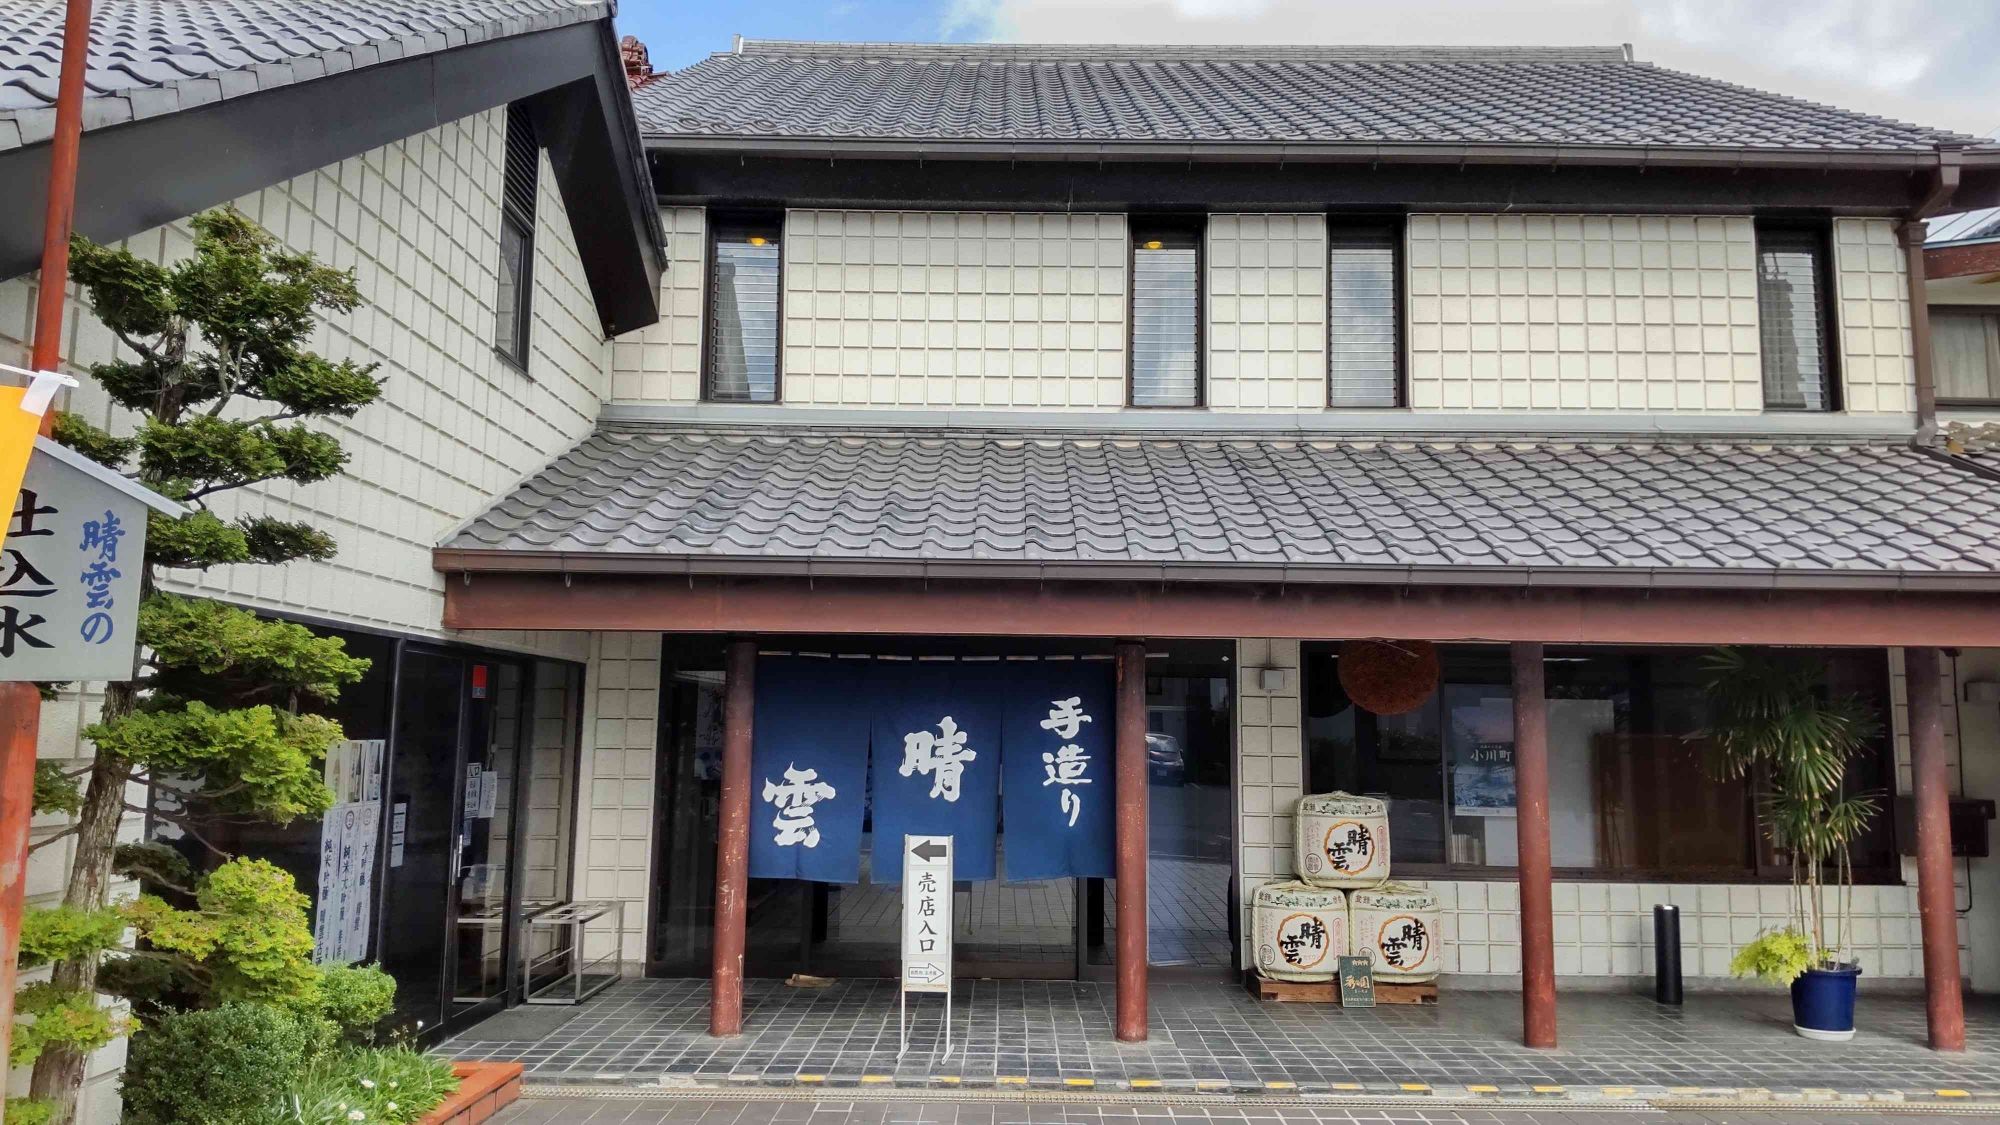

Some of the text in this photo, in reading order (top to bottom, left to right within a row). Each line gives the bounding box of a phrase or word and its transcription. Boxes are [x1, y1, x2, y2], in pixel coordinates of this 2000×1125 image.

[79, 509, 126, 645] 晴雲の
[899, 715, 977, 802] 晴
[1040, 696, 1093, 827] 手造り
[1470, 749, 1512, 762] 小川町
[762, 761, 836, 848] 雲
[1327, 824, 1371, 871] 晴雲
[918, 872, 938, 953] 売店入口
[1280, 916, 1325, 964] 晴雲
[1381, 918, 1427, 966] 晴雲
